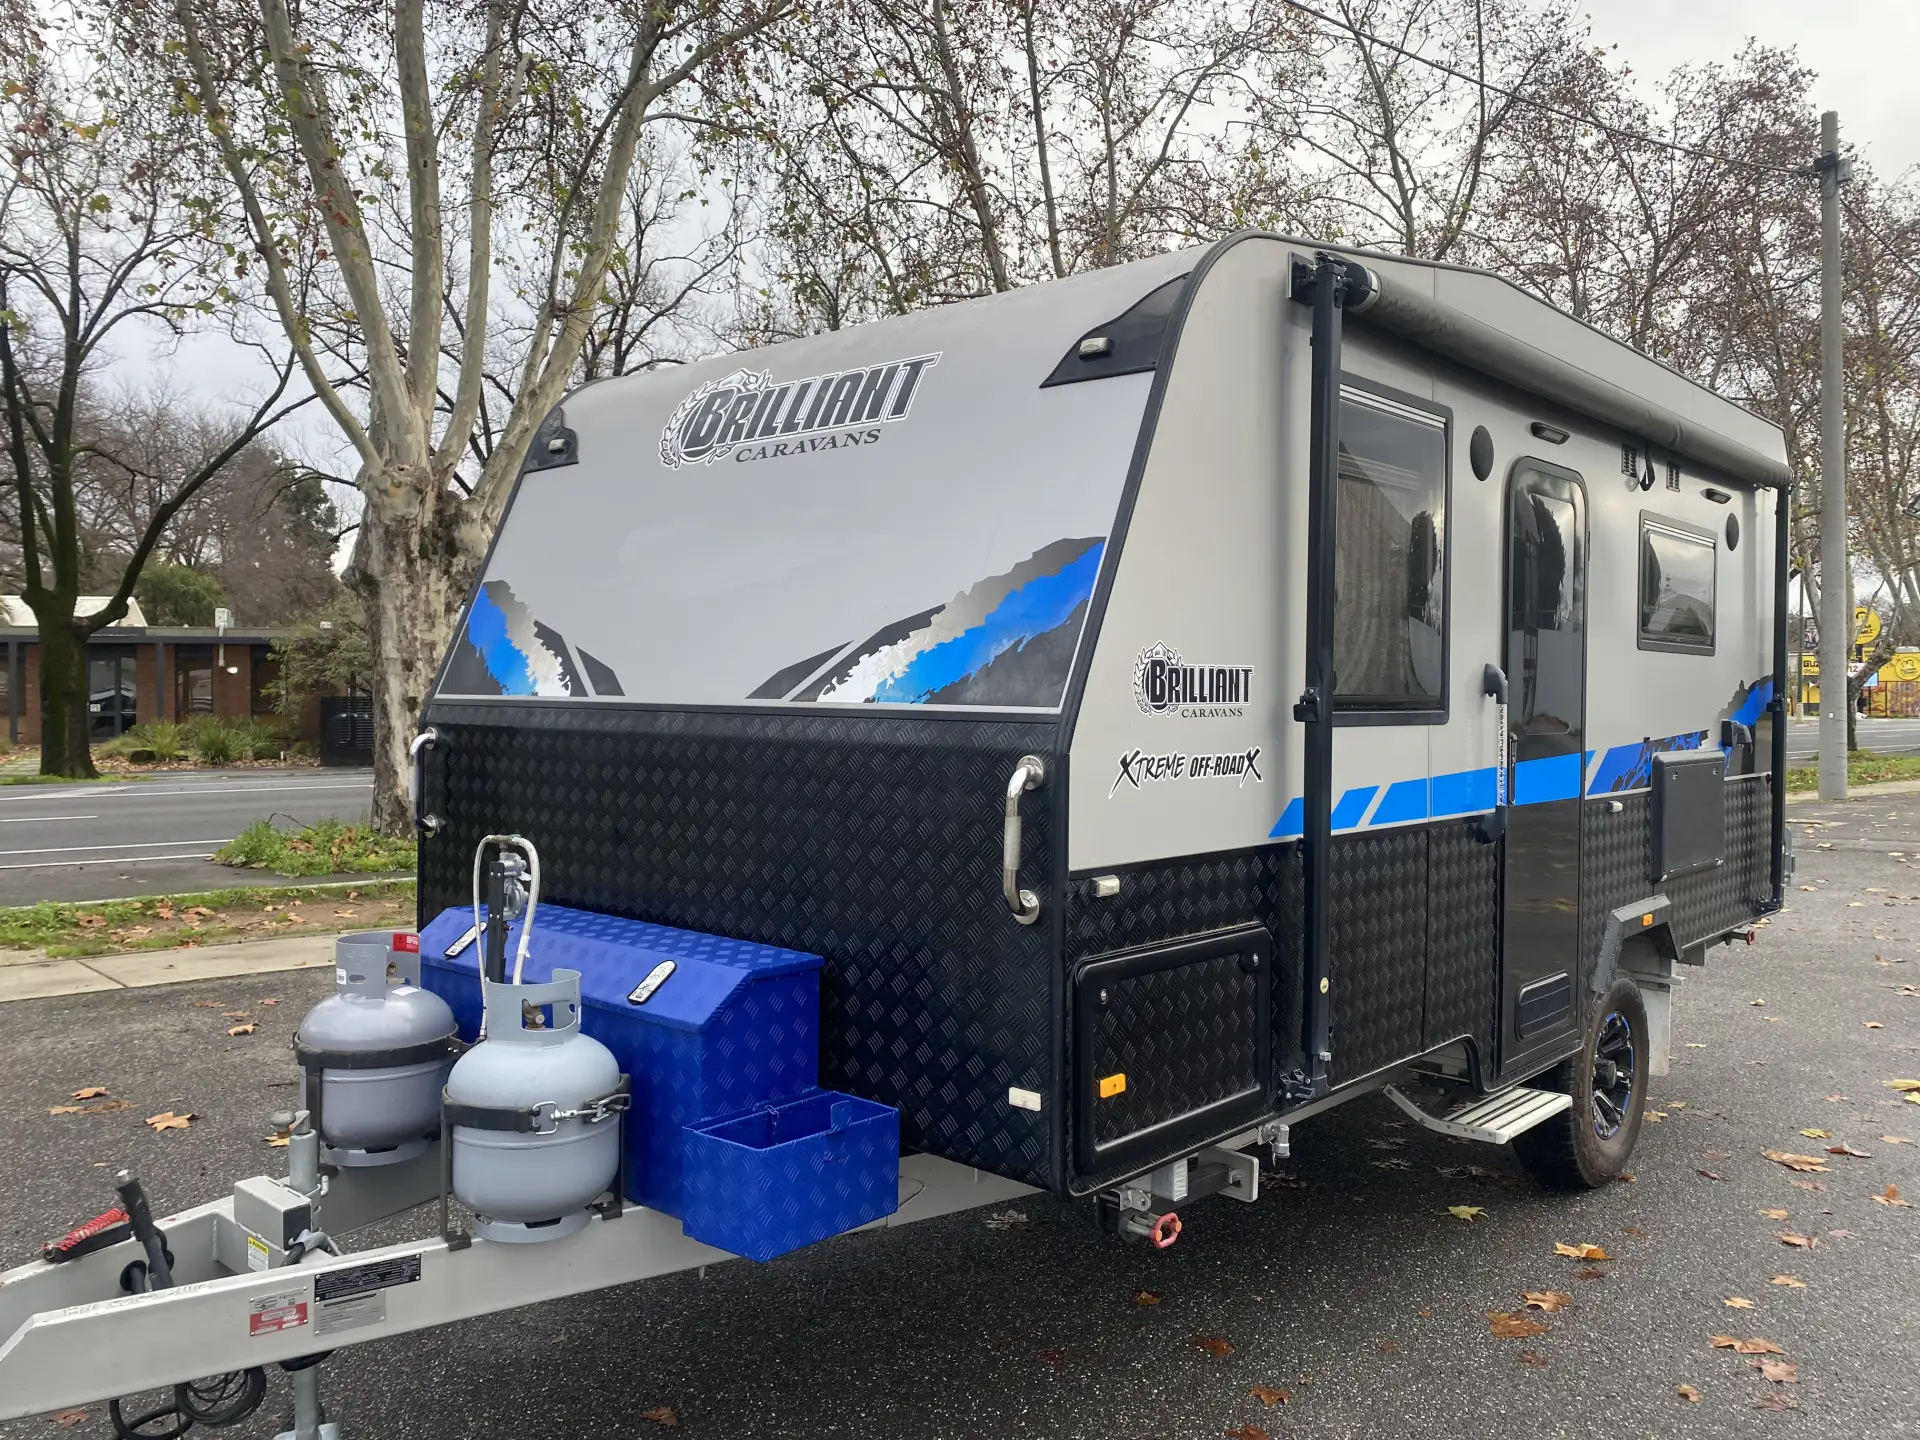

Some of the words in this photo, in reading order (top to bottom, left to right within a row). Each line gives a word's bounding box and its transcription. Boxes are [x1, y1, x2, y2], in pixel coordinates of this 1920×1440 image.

[680, 352, 941, 451] BRILLIANT
[735, 428, 881, 463] CARAVANS
[1149, 658, 1253, 703] BRILLIANT
[1181, 708, 1243, 718] CARAVANS
[1109, 748, 1185, 799] XTREME
